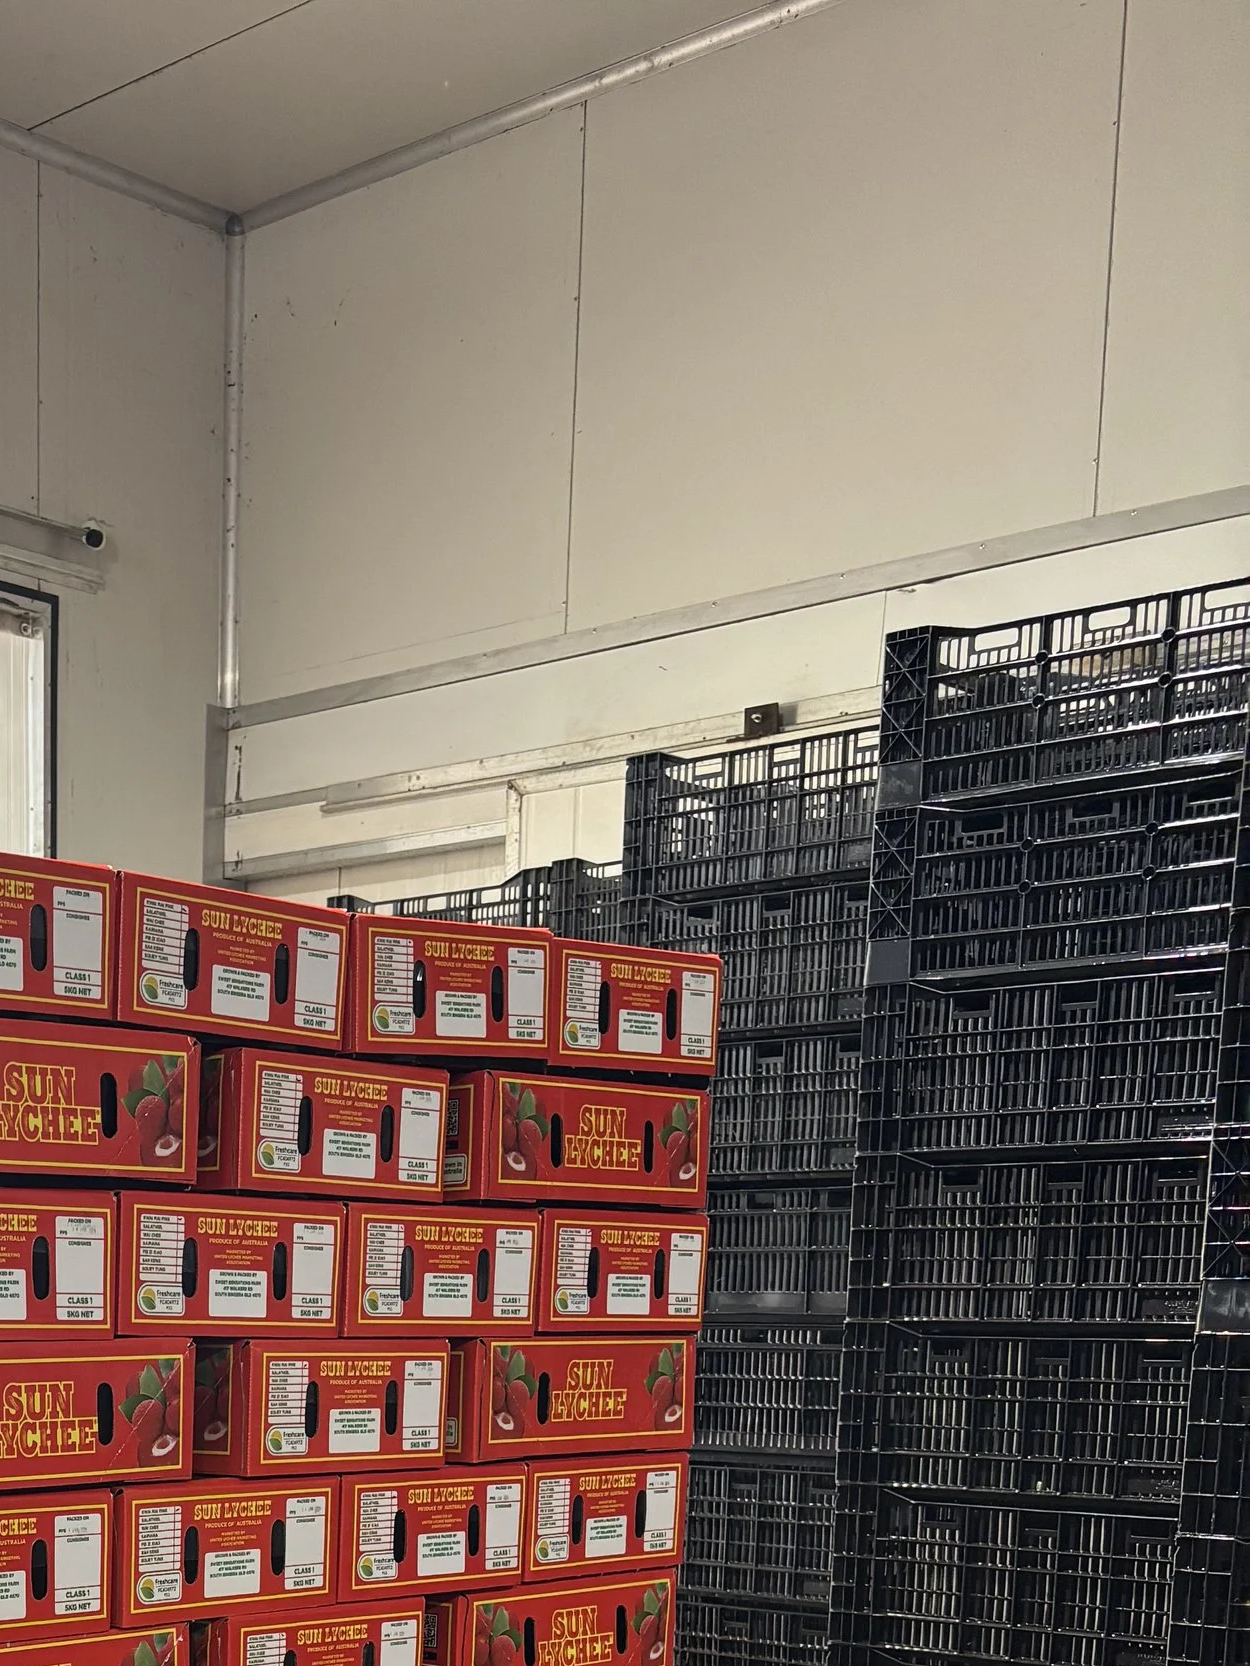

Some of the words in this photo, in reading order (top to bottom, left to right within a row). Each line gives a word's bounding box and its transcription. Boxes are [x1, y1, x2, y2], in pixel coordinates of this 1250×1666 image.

[202, 908, 230, 931] SUN
[233, 913, 282, 940] LYCHEE
[65, 971, 86, 981] CLASS
[611, 962, 632, 979] SUN
[634, 965, 671, 984] LYCHEE
[64, 986, 77, 994] 5KG
[79, 987, 91, 996] NET
[4, 1062, 75, 1104] SUN
[314, 1076, 340, 1096] SUN
[342, 1079, 388, 1101] LYCHEE
[579, 1104, 626, 1138] SUN
[275, 1146, 297, 1154] Freshcare
[565, 1136, 642, 1171] LYCHEE
[3, 1380, 73, 1421] SUN
[579, 1475, 599, 1491] SUN
[601, 1472, 636, 1490] LYCHEE
[195, 1502, 221, 1521] SUN
[224, 1498, 271, 1519] LYCHEE
[552, 1606, 598, 1642] SUN
